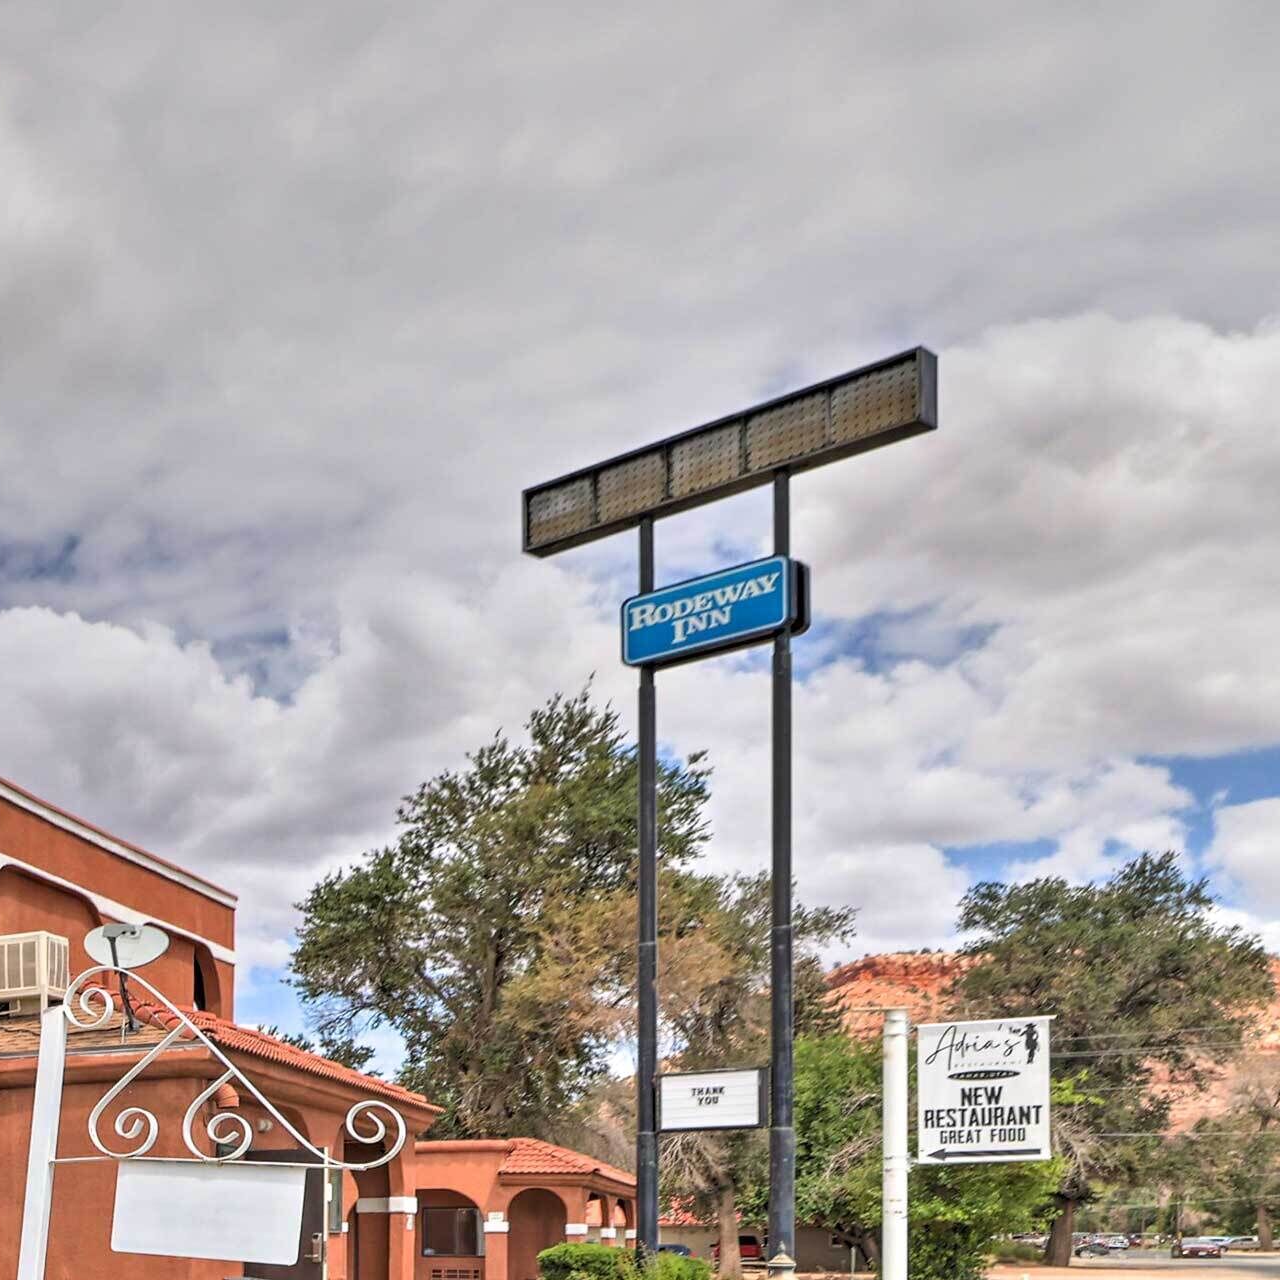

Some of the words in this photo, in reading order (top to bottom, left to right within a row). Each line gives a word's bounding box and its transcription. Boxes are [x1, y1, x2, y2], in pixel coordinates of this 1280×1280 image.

[629, 571, 780, 631] RODEWAY
[671, 606, 732, 644] INN
[691, 1086, 725, 1096] THANK
[697, 1096, 720, 1106] YOU
[960, 1086, 1003, 1106] NEW
[924, 1105, 1042, 1129] RESTAURANT
[940, 1129, 981, 1145] GREAT
[991, 1127, 1026, 1143] FOOD
